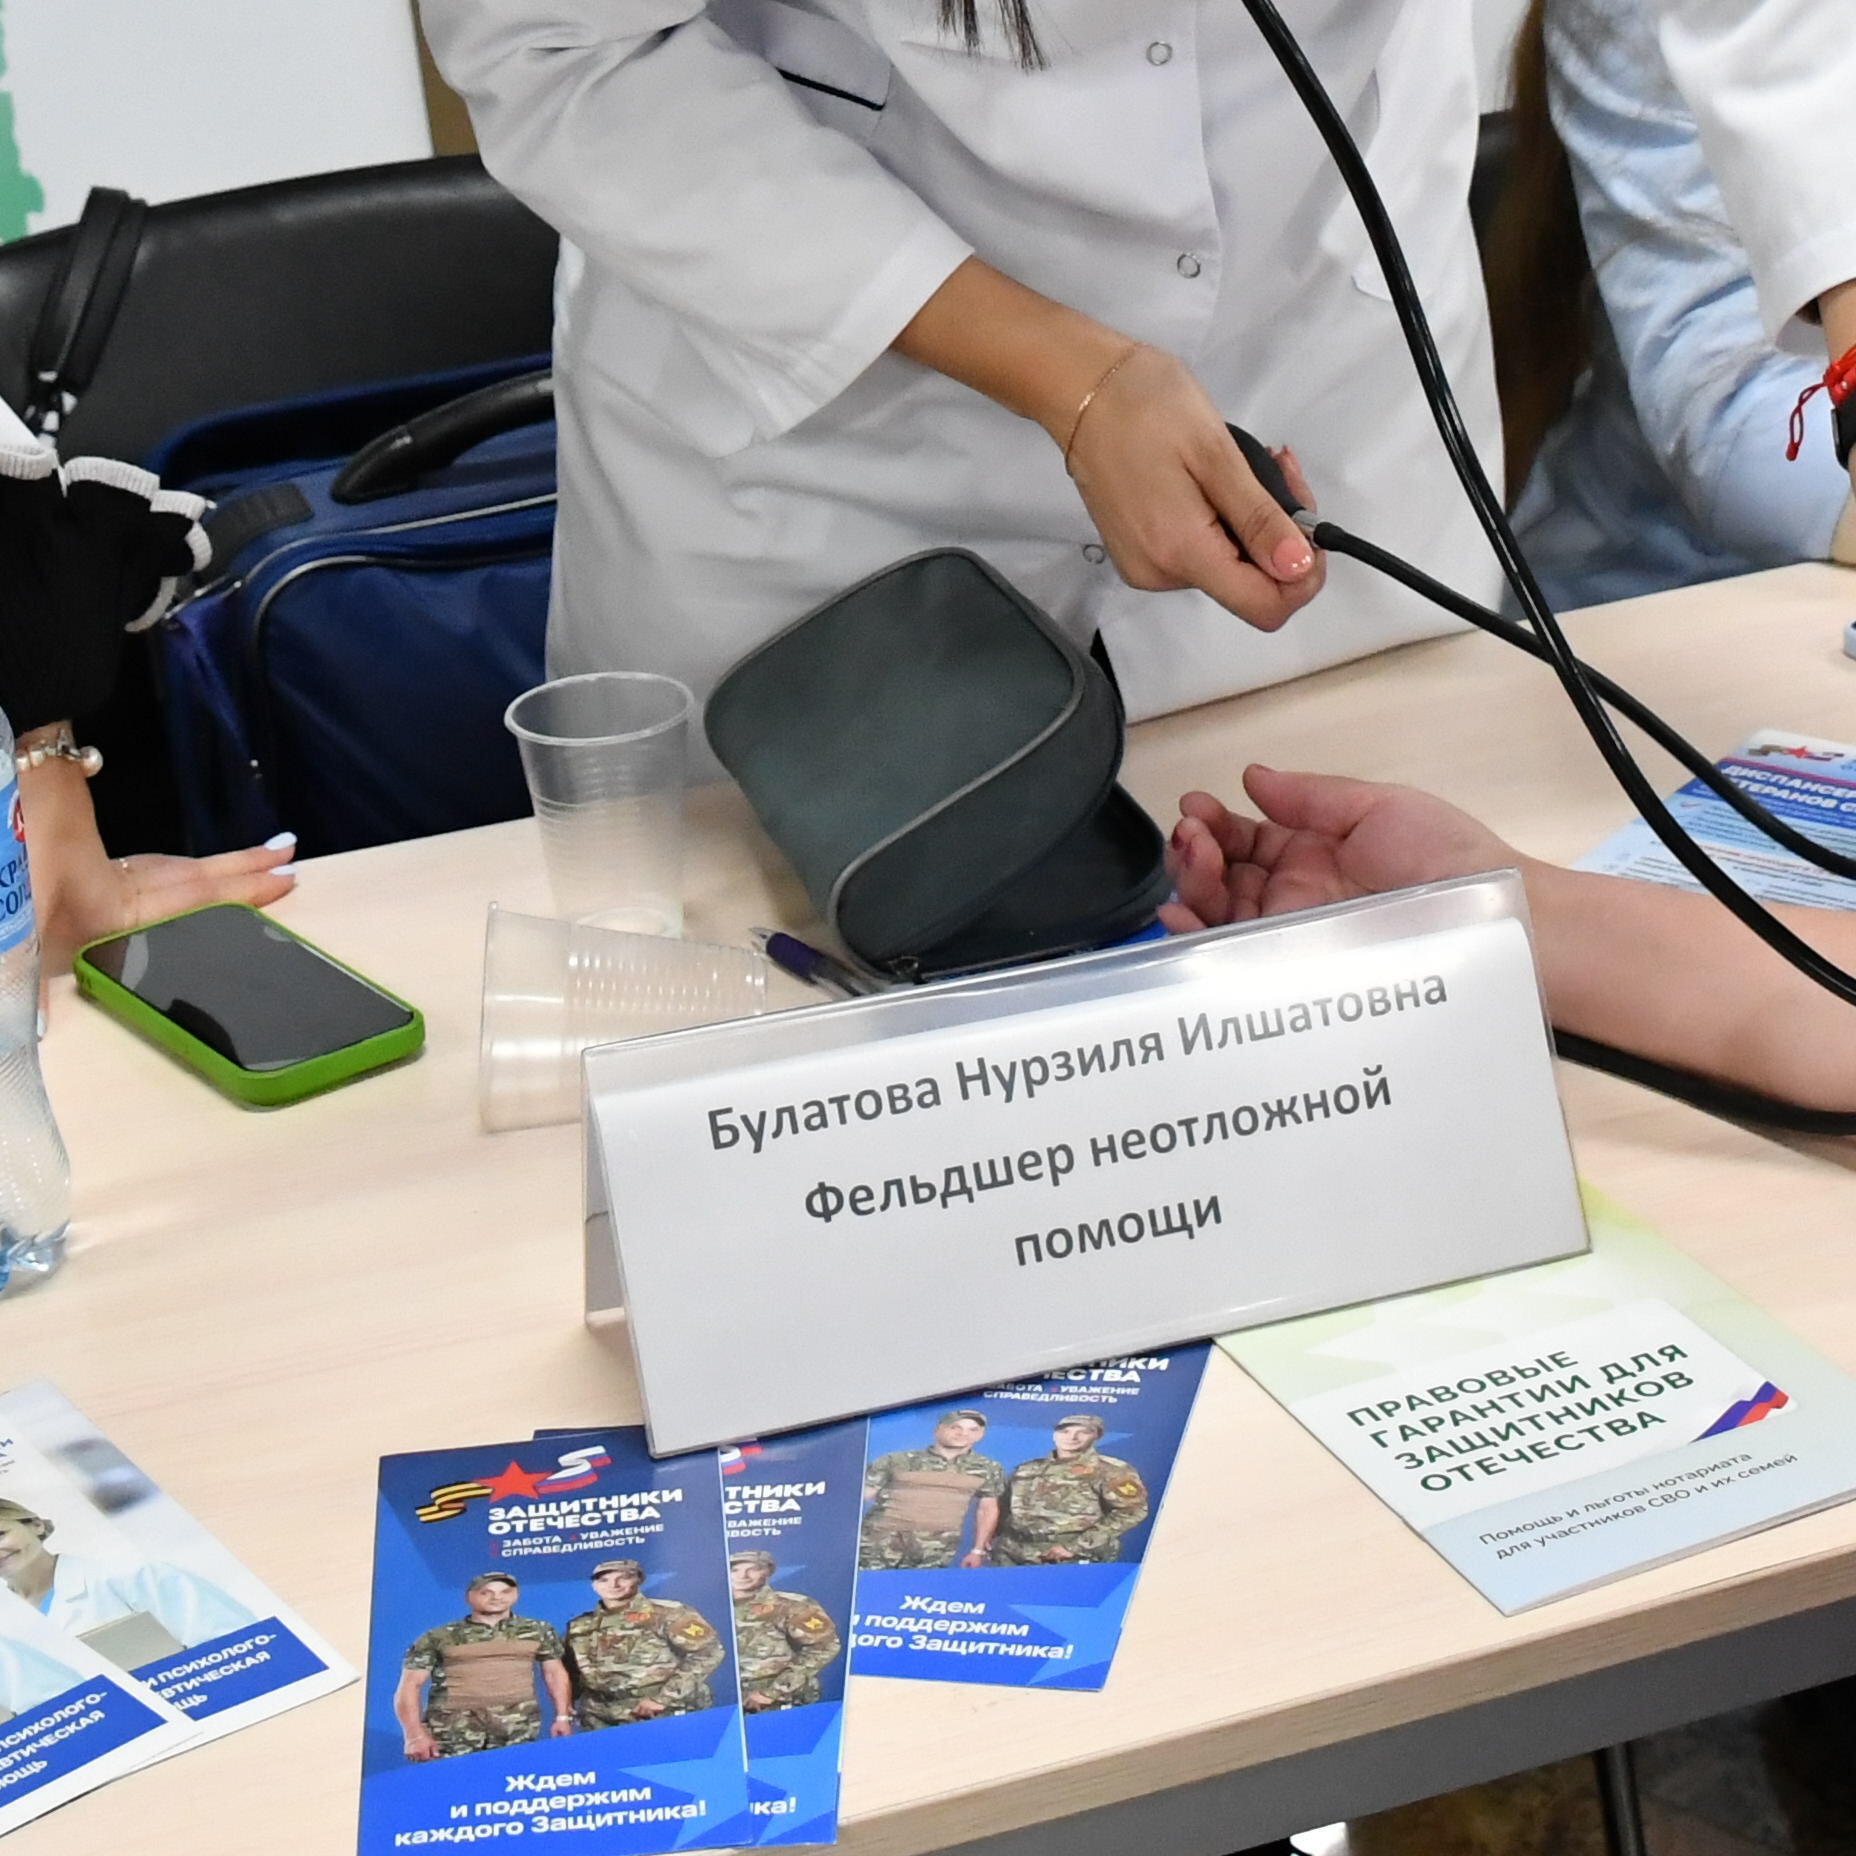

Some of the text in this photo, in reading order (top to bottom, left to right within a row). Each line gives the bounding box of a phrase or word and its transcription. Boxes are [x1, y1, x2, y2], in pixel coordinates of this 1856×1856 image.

[707, 966, 1449, 1153] Булатова Нурзиля Илшатовна
[804, 1064, 1395, 1226] Фельдшер неотложной
[1014, 1189, 1224, 1268] помощи
[982, 1390, 1119, 1404] СПРАВЕДЛИВОСТЬ
[1059, 1383, 1141, 1396] УВАЖЕНИЕ
[1347, 1350, 1579, 1431] ПРАВОВЫЕ
[1369, 1341, 1690, 1449] ГАРАНТИИ ДЛЯ
[1393, 1370, 1696, 1472] ЗАЩИТНИКОВ
[1419, 1409, 1668, 1494] ОТЕЧЕСТВА
[487, 1488, 684, 1522] ЗАЩИТНИКИ
[724, 1480, 827, 1501] ТНИКИ
[1479, 1452, 1753, 1546] Помощь и льготы нотариата
[1496, 1451, 1799, 1561] для участников СВО и их семей
[487, 1505, 662, 1536] ОТЕЧЕСТВА
[502, 1522, 665, 1549] ЗАБОТА УВАЖЕНИЕ
[728, 1516, 803, 1529] ВАЖЕНИЕ
[501, 1535, 646, 1559] СПРАВЕДЛИВОСТЬ
[899, 1594, 987, 1616] Ждем
[863, 1614, 1030, 1638] поддержим
[158, 1633, 277, 1684] ПСИХОЛОГО-
[908, 1633, 1074, 1660] Защитника!
[159, 1650, 272, 1700] ВТИЧЕСКАЯ
[505, 1770, 597, 1794] Ждем
[450, 1785, 652, 1820] и поддержим
[394, 1799, 708, 1848] каждого Защитника!
